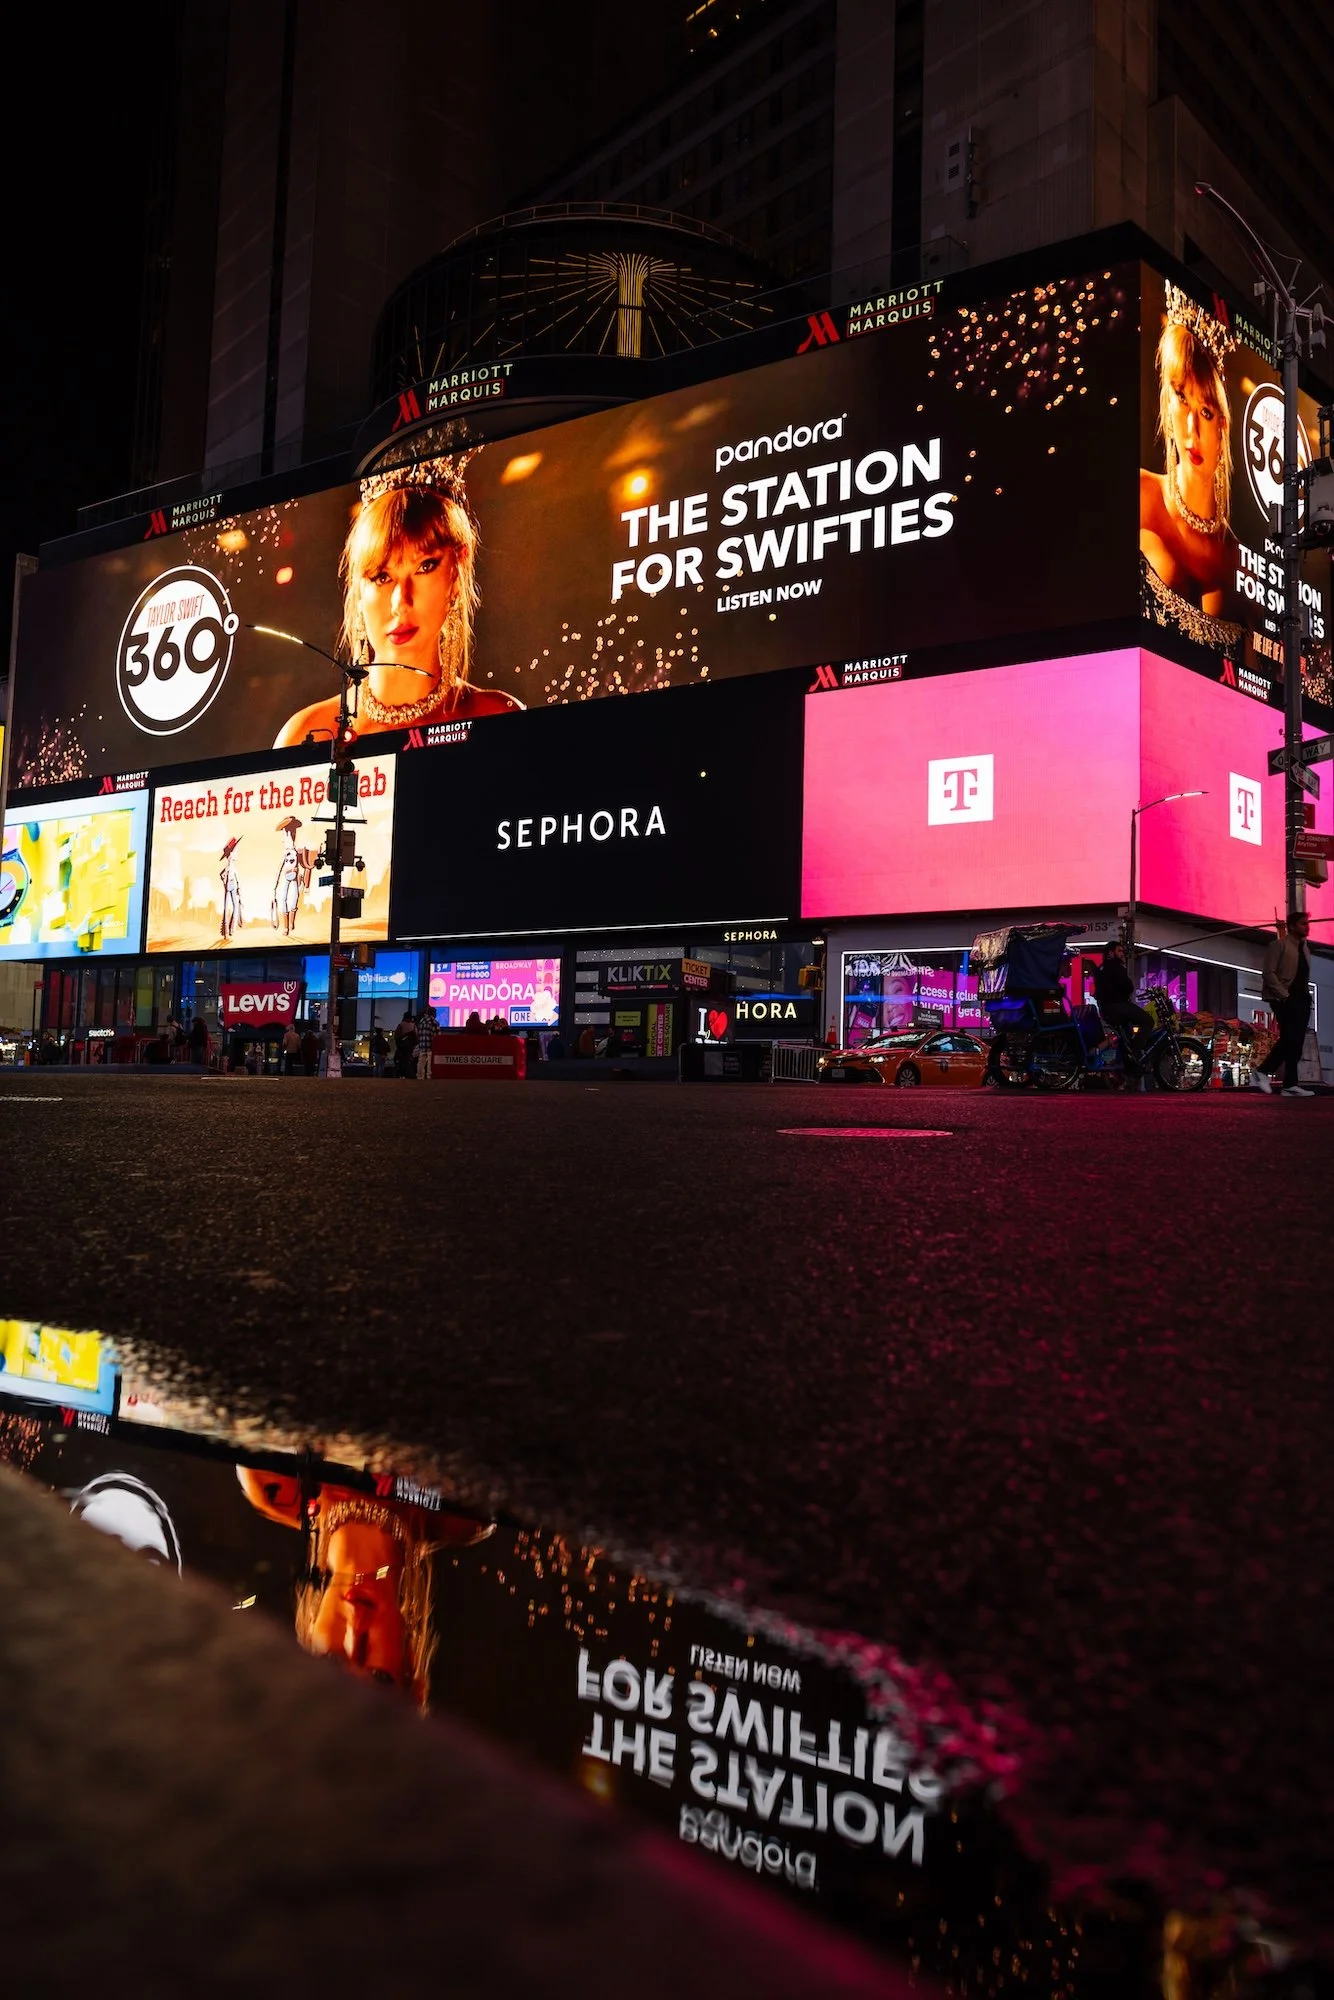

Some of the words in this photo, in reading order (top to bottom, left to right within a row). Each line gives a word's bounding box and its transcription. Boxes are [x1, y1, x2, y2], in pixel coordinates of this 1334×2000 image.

[849, 280, 944, 319] MARRIOTT
[849, 300, 932, 335] MARQUIS
[1235, 313, 1282, 358] MARRIOT
[428, 363, 514, 395] MARRIOTT
[428, 382, 502, 411] MARQUIS
[715, 417, 843, 472] pandora
[620, 492, 709, 548] THE
[720, 437, 942, 527] STATION
[172, 493, 223, 516] MARRIOTT
[171, 507, 216, 529] MARQUIS
[611, 548, 704, 600] FOR
[714, 491, 955, 580] SWIFTIES
[1236, 570, 1266, 607] FOR
[1238, 543, 1267, 580] THE
[1267, 562, 1322, 613] STION
[716, 589, 773, 612] LISTEN
[775, 579, 823, 603] NOW
[147, 601, 177, 628] TAYLOR
[178, 594, 205, 621] SWIFT
[843, 654, 909, 673] MARRIOTT
[843, 666, 901, 684] MARQUIS
[1238, 667, 1272, 690] MARRIOTT
[1238, 678, 1268, 700] MARQUIS
[427, 721, 473, 736] MARRIOTT
[427, 731, 468, 745] MARQUIS
[1305, 743, 1326, 758] WAY
[116, 770, 149, 783] MARRIOTT
[116, 779, 146, 791] MARQUIS
[160, 790, 219, 823] Reach
[223, 787, 255, 815] for
[259, 781, 294, 810] the
[299, 776, 329, 805] Re
[943, 768, 978, 811] T
[1237, 787, 1255, 830] T
[496, 805, 667, 851] SEPHORA
[723, 930, 778, 942] SEPHORA
[495, 961, 533, 970] BROADWAY
[607, 964, 672, 983] KLIKTIX
[684, 961, 709, 976] TICKET
[449, 980, 536, 1001] PANDORA
[683, 974, 708, 987] CENTER
[514, 1012, 531, 1022] ONE
[697, 1007, 708, 1036] I
[736, 1002, 798, 1019] HORA
[445, 1056, 469, 1064] TIMES
[470, 1056, 503, 1064] SQUARE
